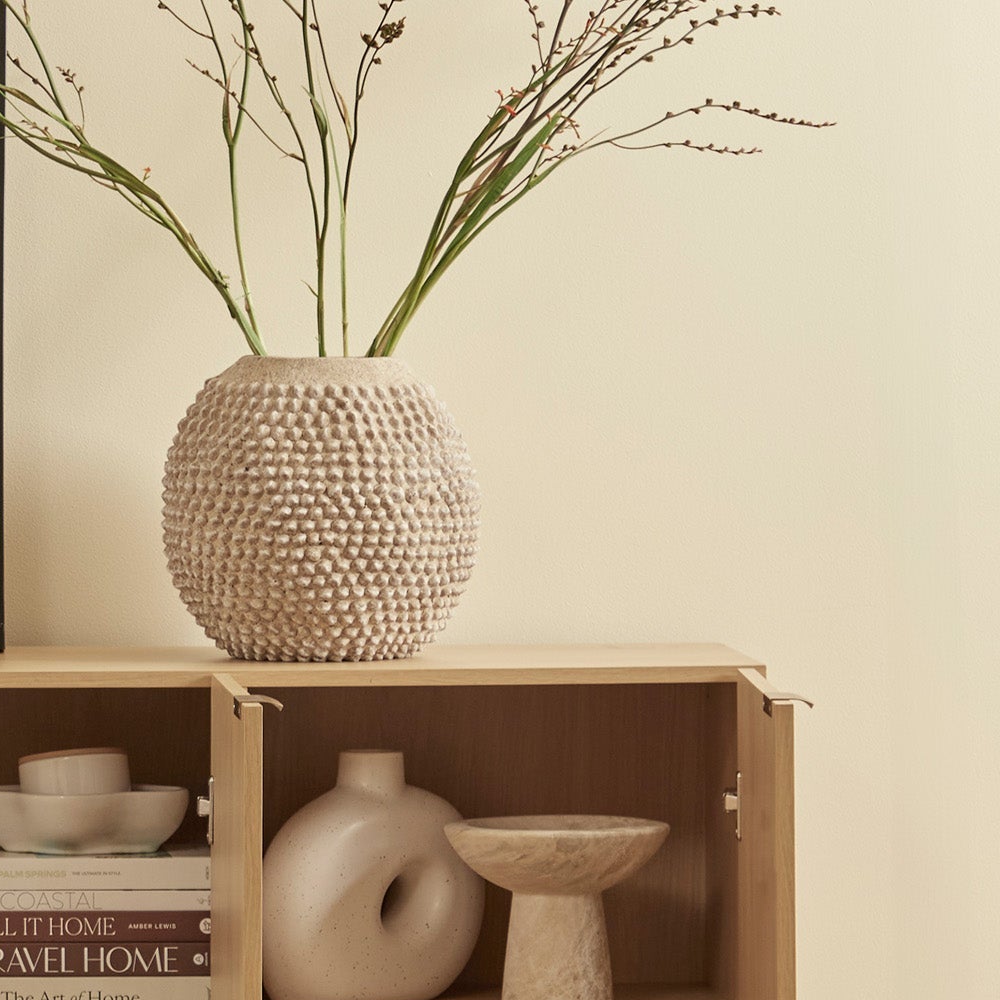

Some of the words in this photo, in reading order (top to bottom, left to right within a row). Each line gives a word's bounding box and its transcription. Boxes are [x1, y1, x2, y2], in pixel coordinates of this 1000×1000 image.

[25, 870, 67, 878] SPRINGS
[0, 892, 102, 910] COASTAL
[23, 917, 42, 936] IT
[49, 917, 116, 936] HOME
[84, 947, 178, 973] HOME
